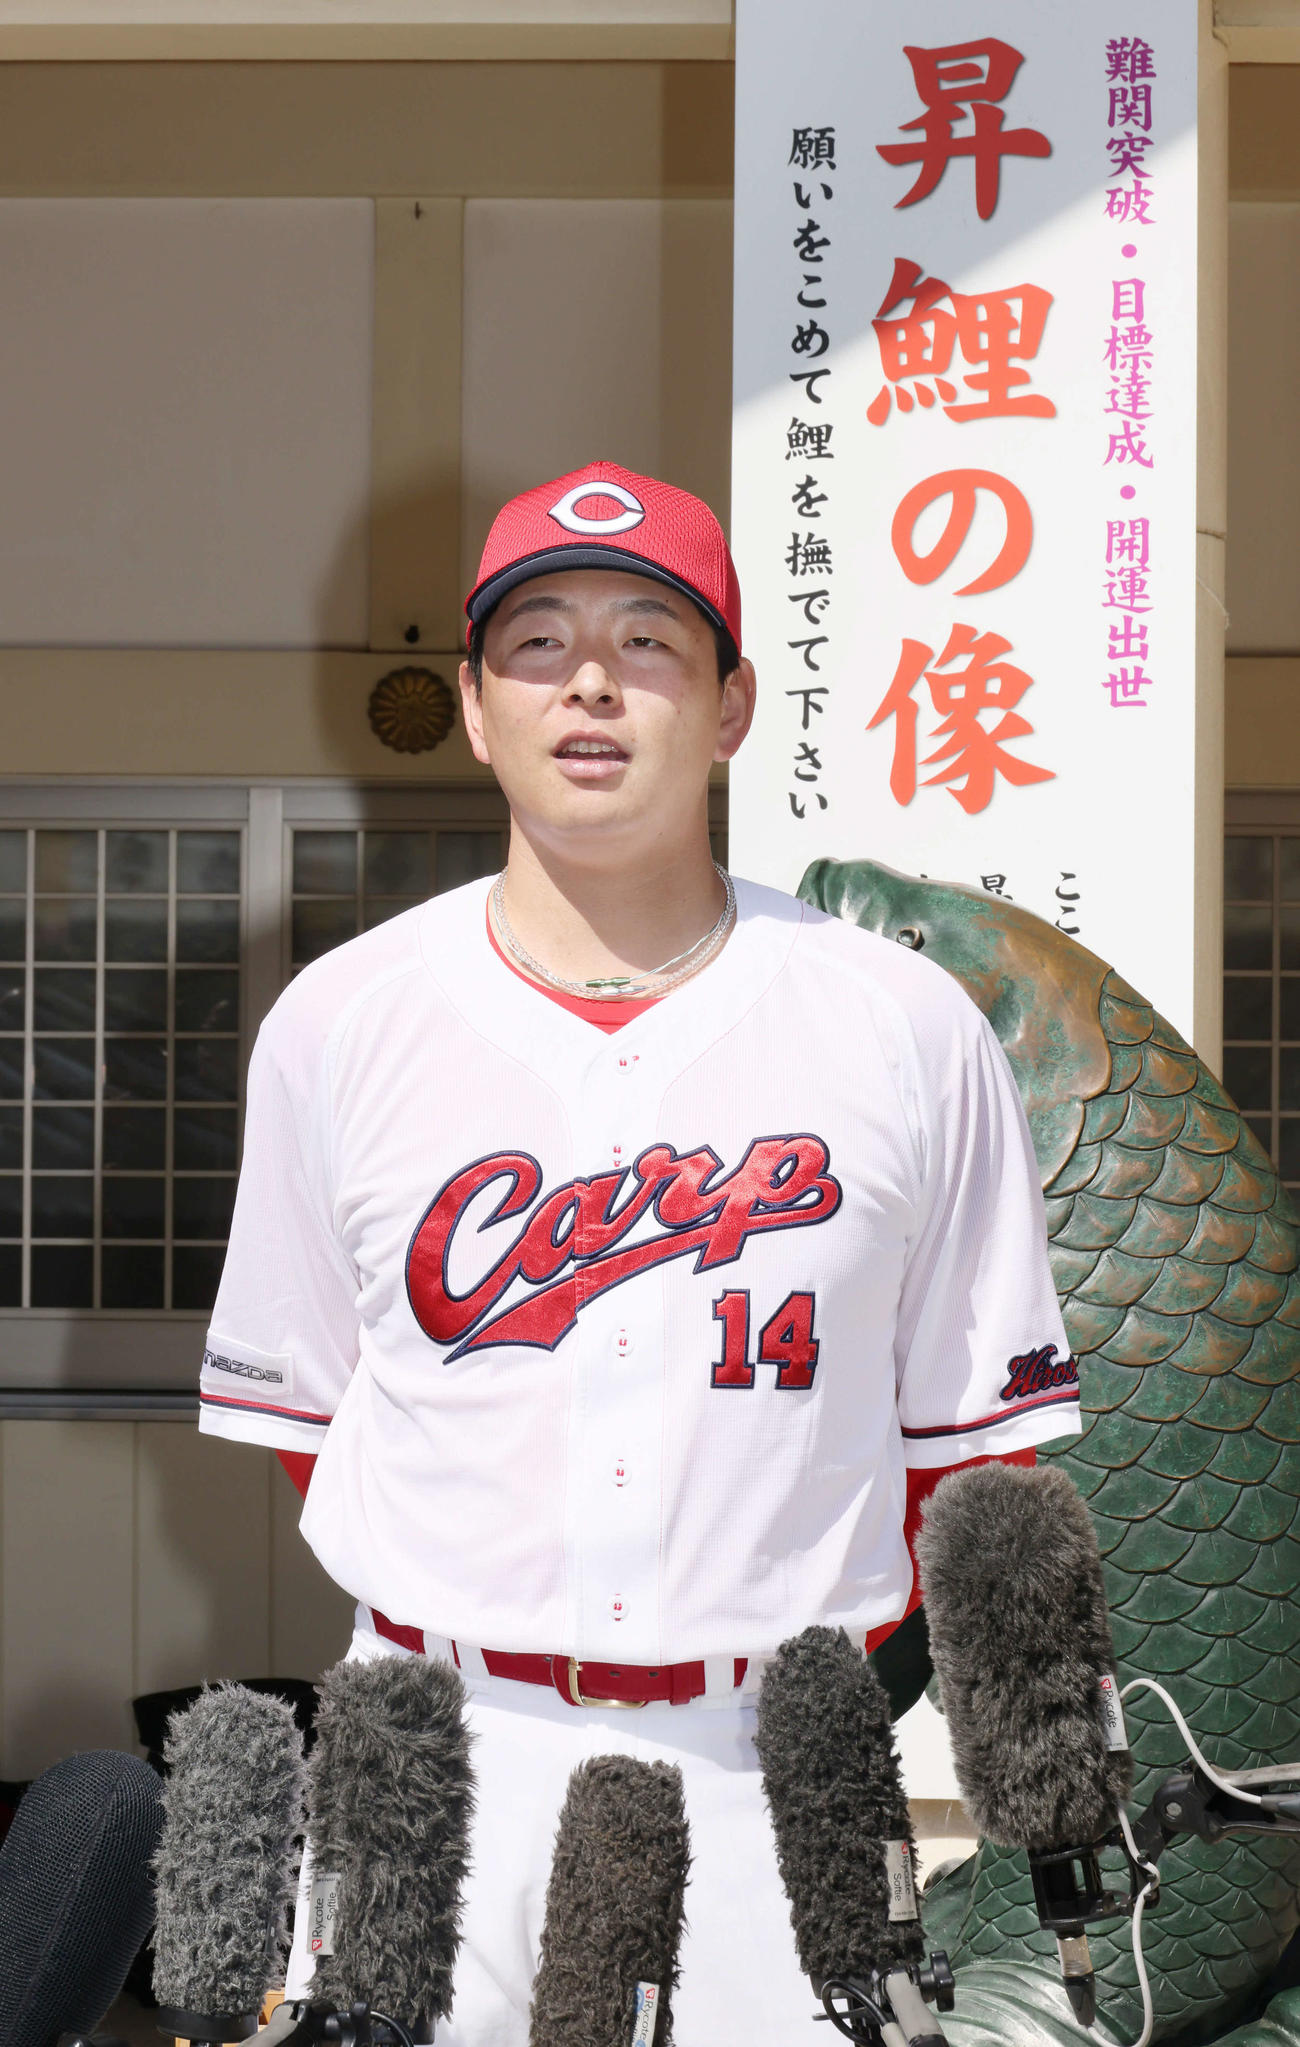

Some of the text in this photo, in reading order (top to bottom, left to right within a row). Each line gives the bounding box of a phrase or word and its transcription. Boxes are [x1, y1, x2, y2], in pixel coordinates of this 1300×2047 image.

[1101, 36, 1156, 708] 難関突破・目標達成・開運出世
[865, 37, 1057, 815] 昇鯉の像
[547, 481, 646, 536] C
[785, 126, 838, 819] 願いをこめて鯉を撫でて下さい
[405, 1132, 843, 1365] Carp
[710, 1289, 820, 1390] 14
[893, 1872, 902, 1902] Softie
[901, 1855, 912, 1896] Rycote
[312, 1897, 326, 1938] Rycote
[640, 2000, 654, 2041] Rycote
